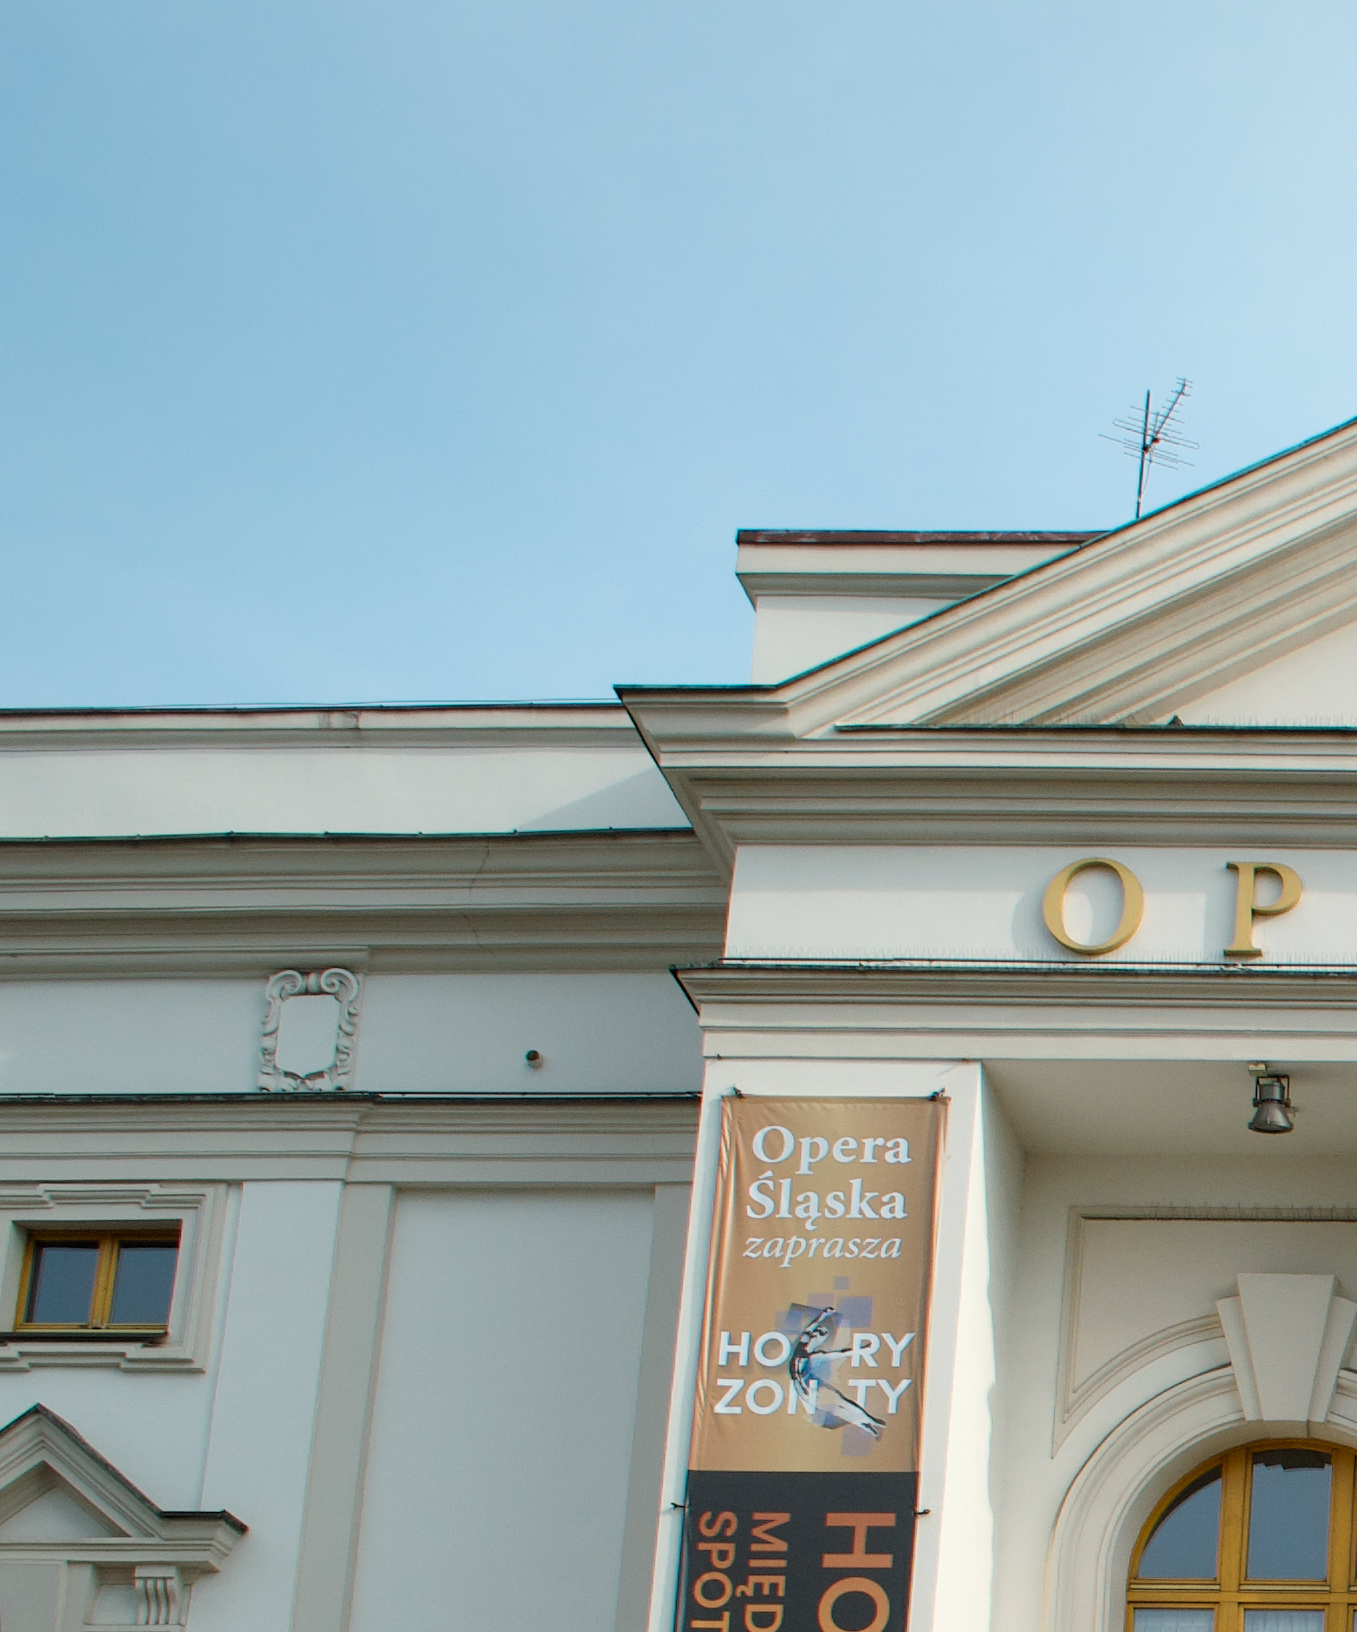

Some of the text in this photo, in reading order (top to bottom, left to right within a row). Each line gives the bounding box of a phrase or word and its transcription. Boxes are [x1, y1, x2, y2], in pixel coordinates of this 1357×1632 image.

[752, 1125, 912, 1175] Opera
[745, 1170, 908, 1231] Śląska
[742, 1235, 902, 1269] zaprasza
